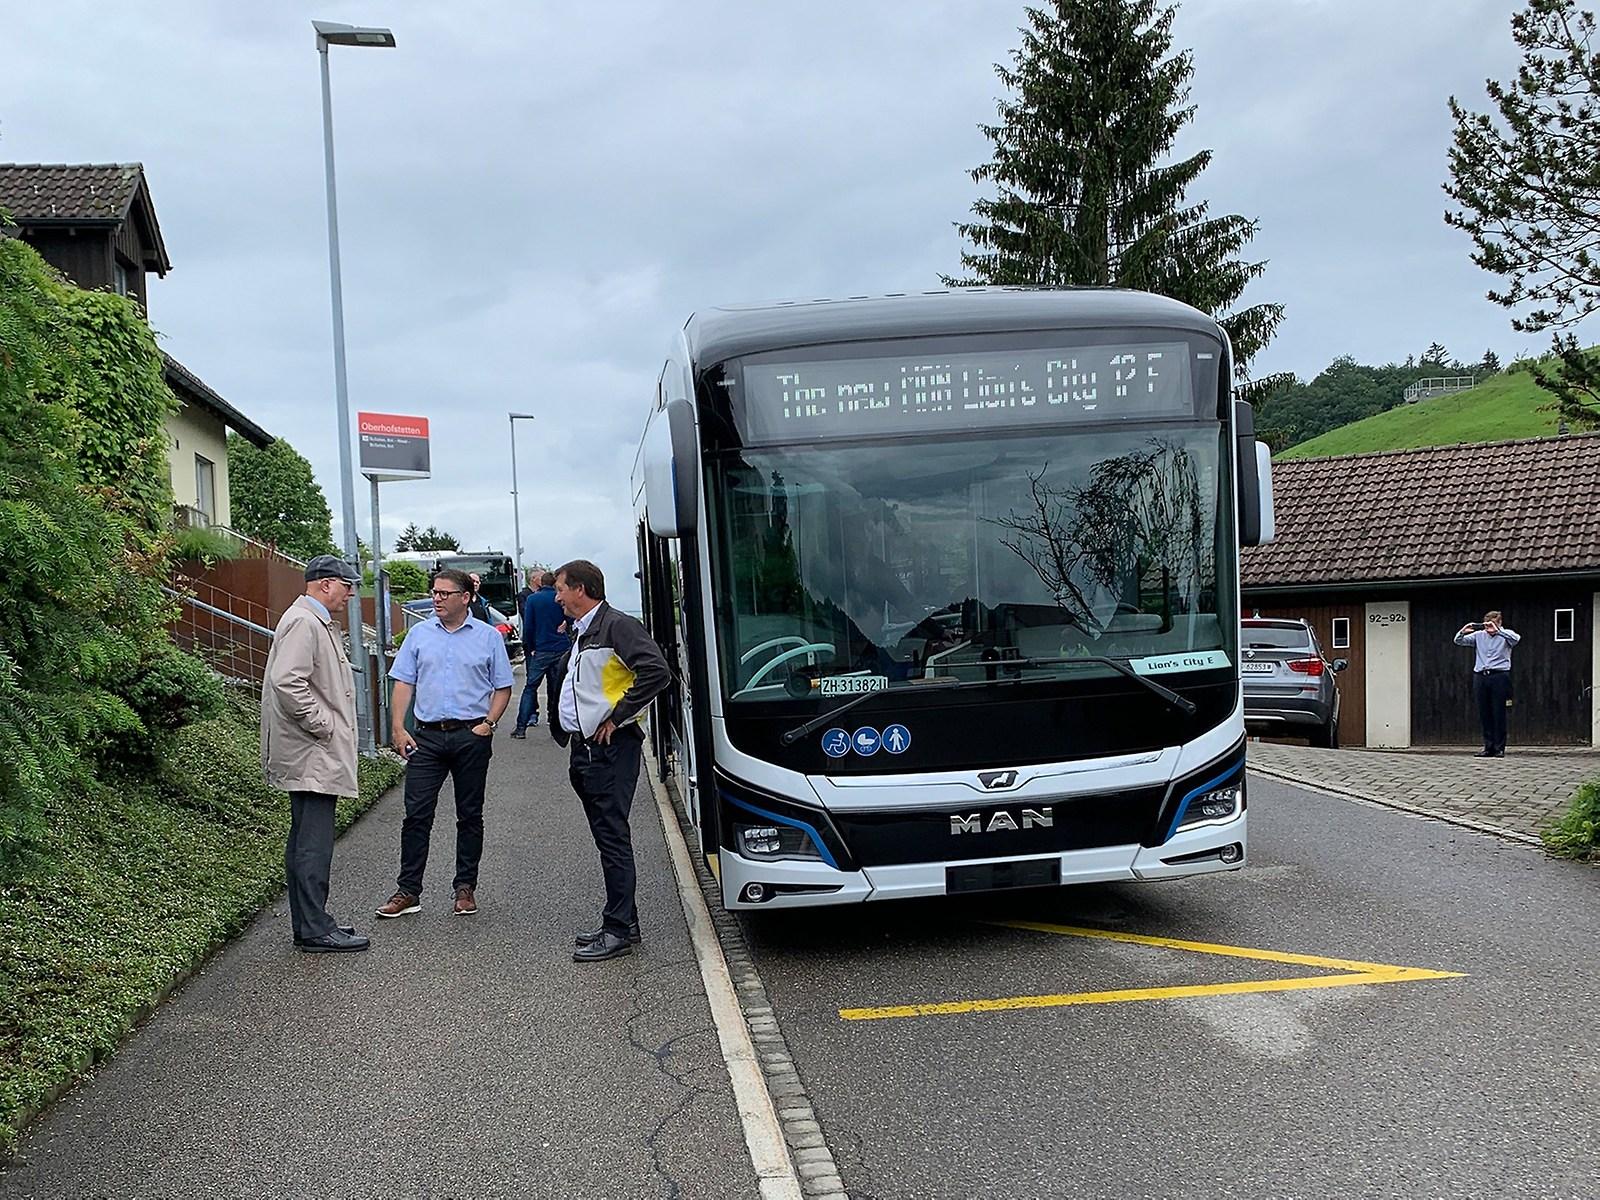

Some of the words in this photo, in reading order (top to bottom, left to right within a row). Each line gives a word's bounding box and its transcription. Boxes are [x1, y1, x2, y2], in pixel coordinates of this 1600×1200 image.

[776, 373, 826, 418] The
[837, 382, 890, 414] new
[1148, 660, 1179, 670] Lion's
[1183, 658, 1204, 667] City
[1207, 656, 1214, 664] E
[950, 807, 1054, 835] MAN
